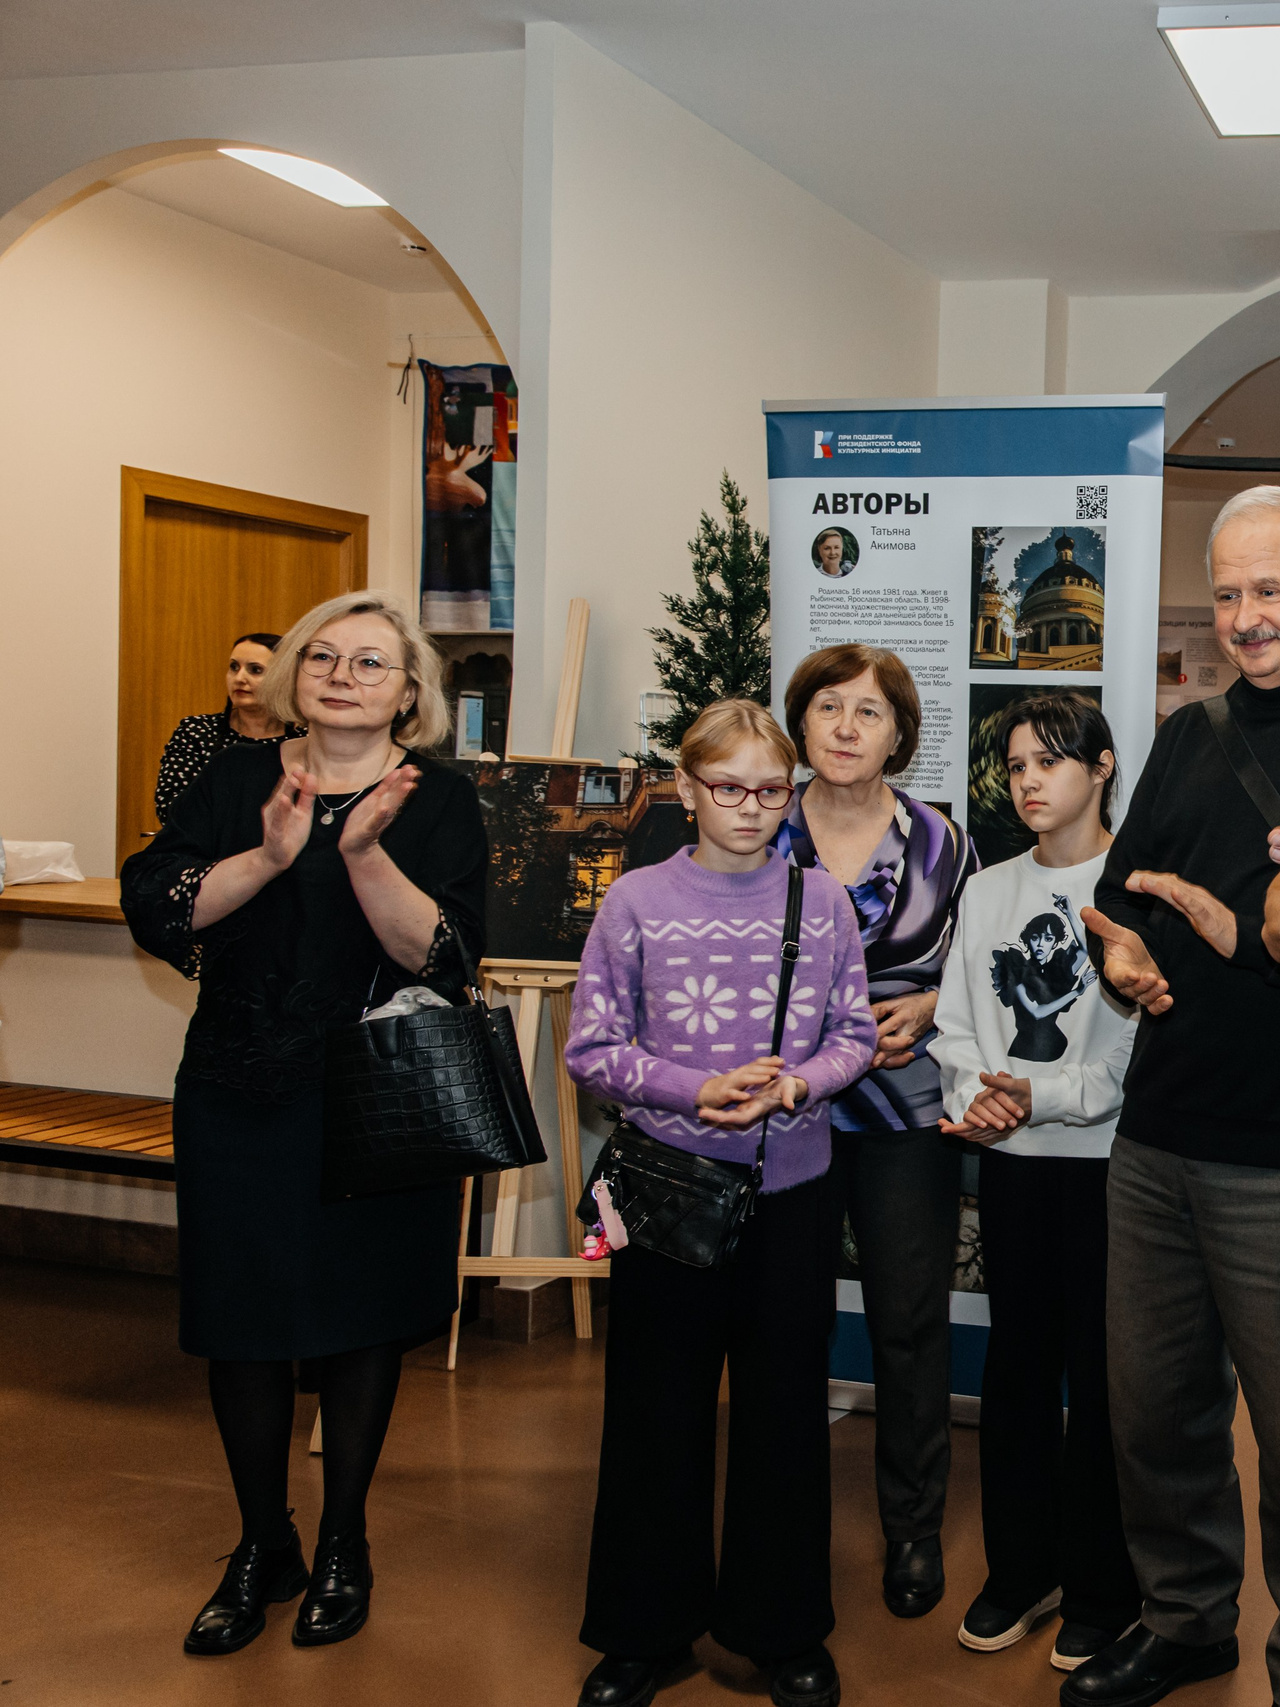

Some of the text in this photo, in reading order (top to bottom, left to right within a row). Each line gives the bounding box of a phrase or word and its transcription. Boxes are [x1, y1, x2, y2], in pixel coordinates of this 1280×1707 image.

[812, 493, 929, 514] АВТОРЫ
[871, 526, 910, 536] Татьяна
[870, 541, 916, 550] Акимова
